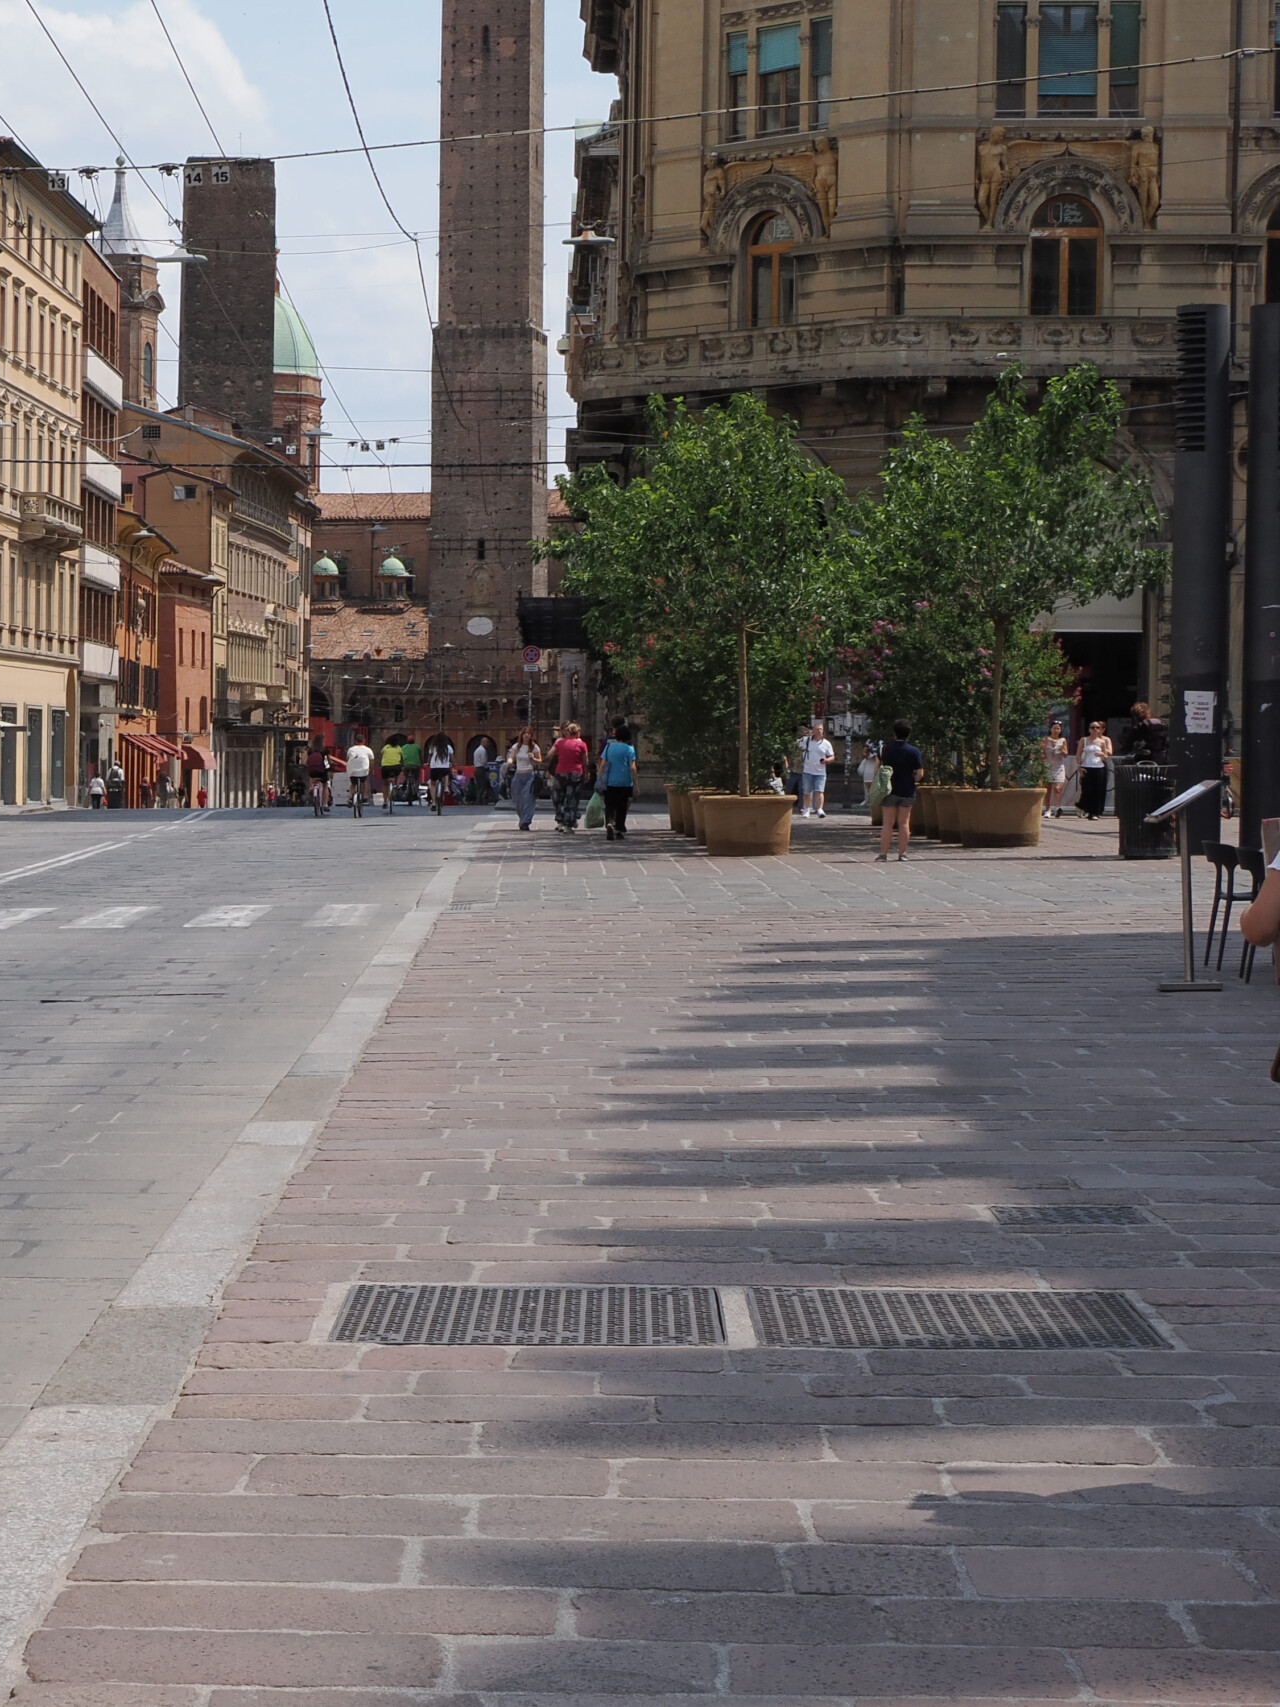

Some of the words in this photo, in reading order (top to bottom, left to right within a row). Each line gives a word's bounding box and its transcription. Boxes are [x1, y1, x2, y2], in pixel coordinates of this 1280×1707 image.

[185, 172, 202, 184] 14
[213, 171, 229, 183] 15
[50, 178, 65, 189] 13
